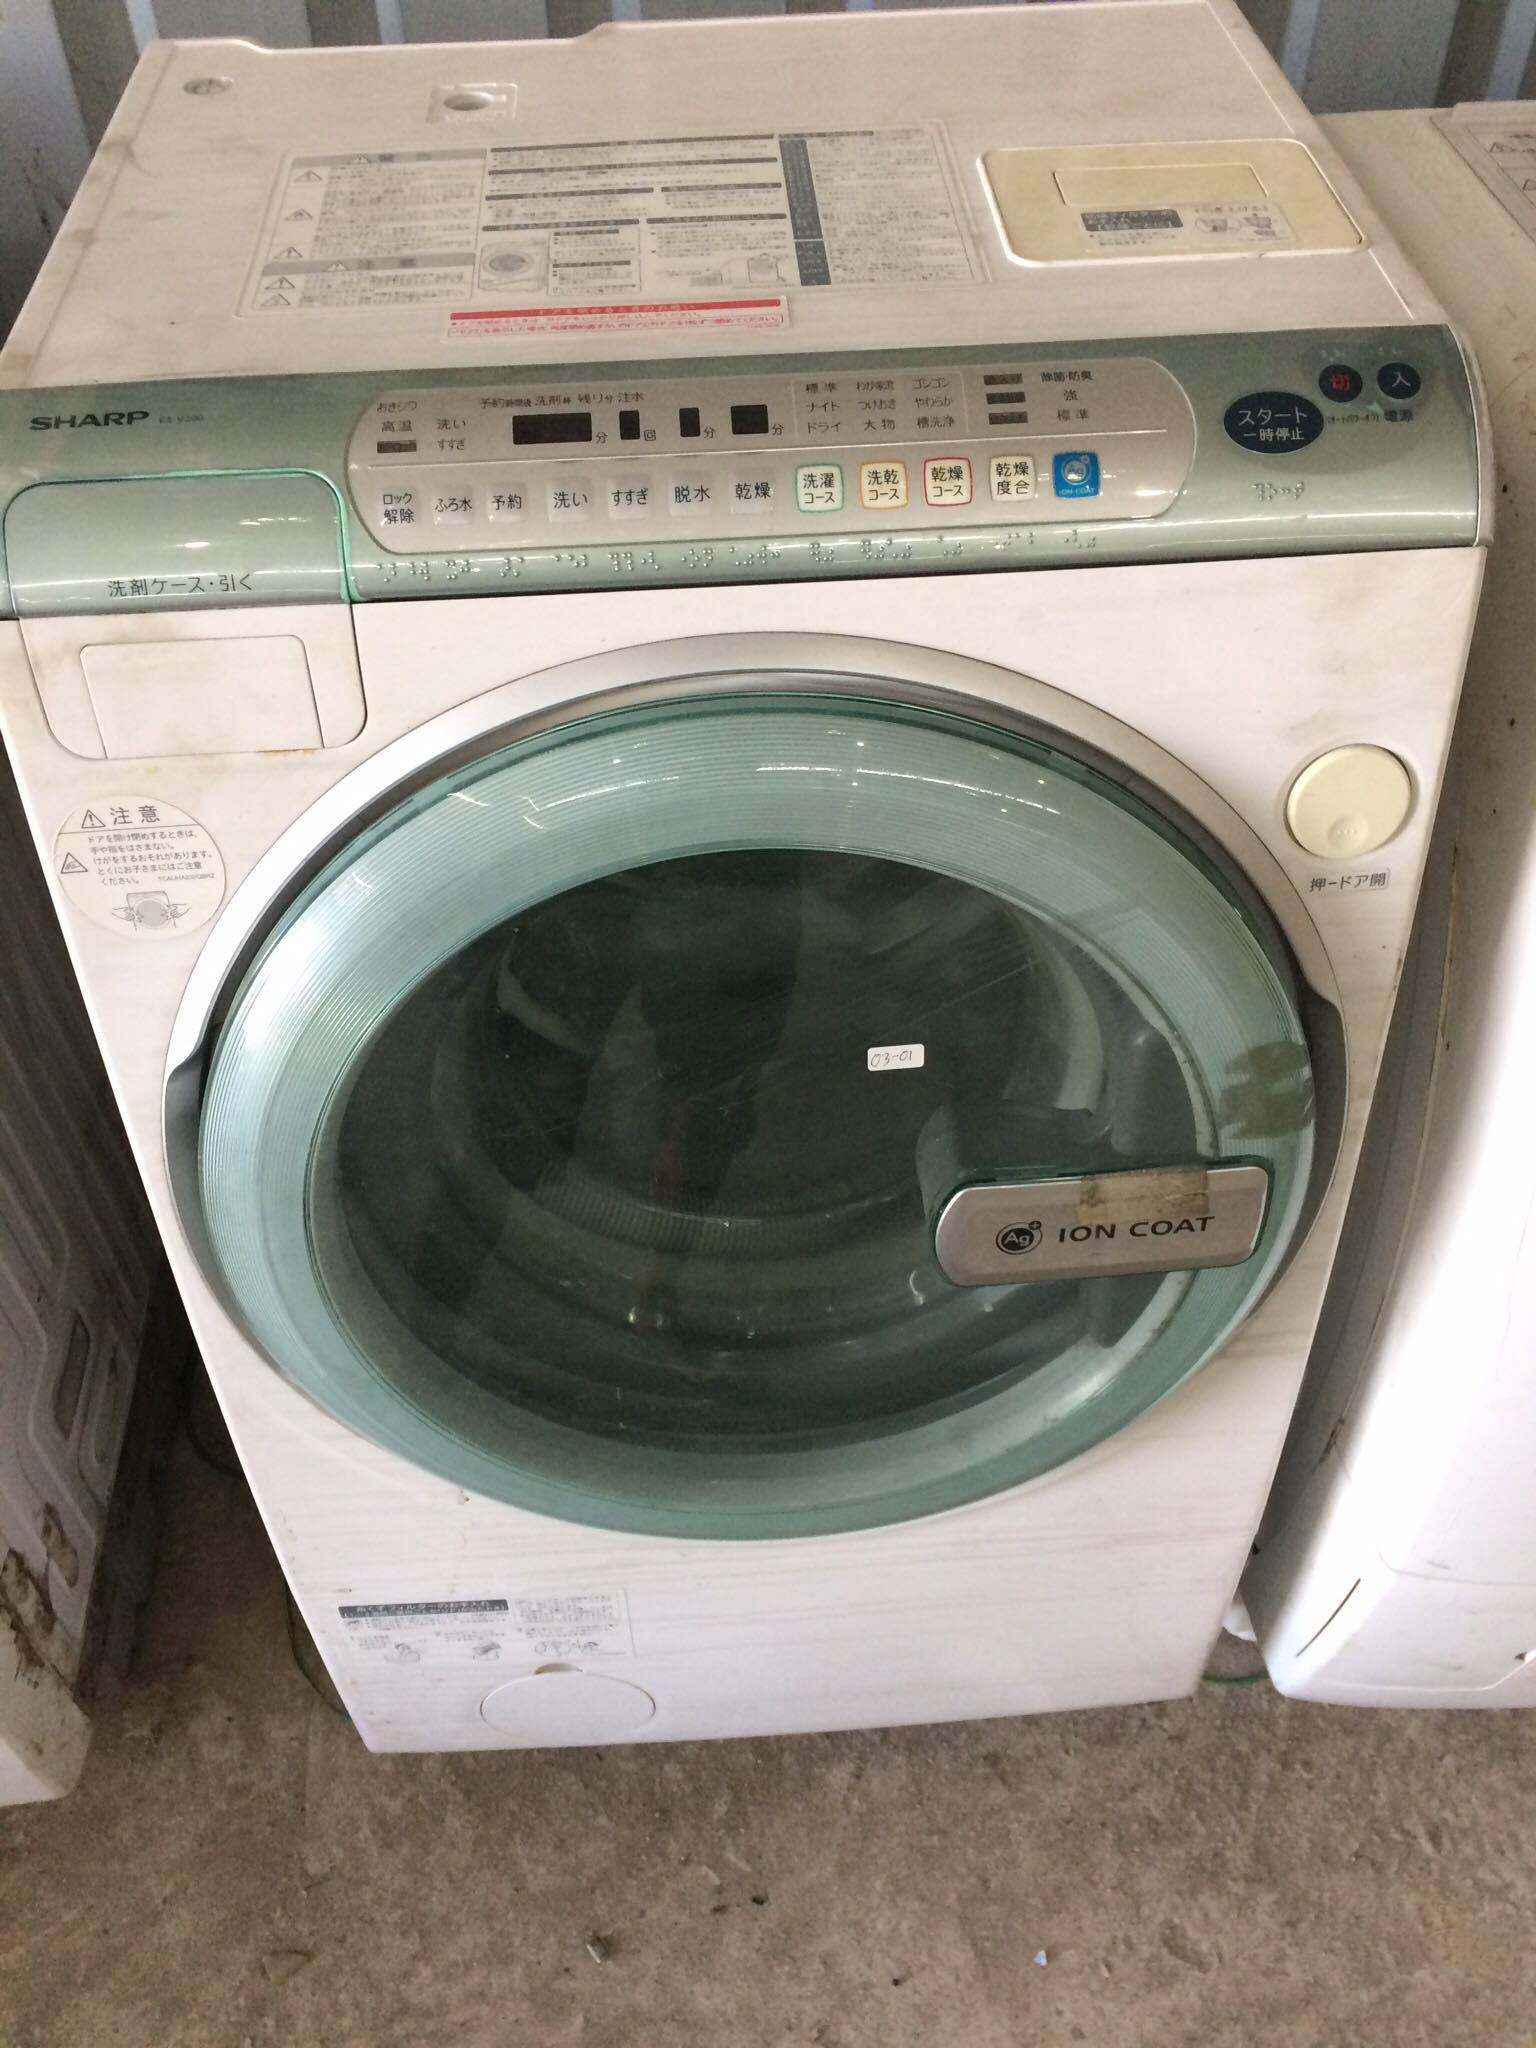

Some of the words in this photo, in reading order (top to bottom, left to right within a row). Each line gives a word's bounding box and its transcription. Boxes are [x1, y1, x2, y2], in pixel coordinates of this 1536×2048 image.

[1391, 371, 1412, 388] 入
[806, 401, 841, 413] ナイト
[1238, 405, 1308, 426] スタート
[29, 410, 150, 431] SHARP
[437, 418, 467, 430] 洗い
[807, 421, 841, 434] ドライ
[863, 419, 896, 432] 大物
[595, 431, 609, 444] 分
[643, 429, 657, 442] 回
[703, 426, 716, 439] 分
[771, 423, 785, 436] 分
[1243, 427, 1305, 443] 一時停止
[867, 469, 899, 486] 洗乾
[931, 465, 964, 482] 乾燥
[995, 461, 1029, 478] 乾燥
[803, 472, 835, 489] 洗濯
[996, 480, 1030, 496] 度合
[383, 492, 413, 505] ロック
[611, 487, 648, 506] すすぎ
[674, 484, 711, 504] 脱水
[735, 481, 772, 500] 乾燥
[804, 491, 836, 504] コース
[868, 488, 900, 501] コース
[933, 484, 964, 498] コース
[435, 497, 473, 513] ふろ水
[491, 494, 522, 511] 予約
[552, 491, 588, 509] 洗い
[384, 508, 415, 525] 解除
[107, 573, 253, 598] 洗剤ケース・引く
[109, 804, 161, 826] 注意
[870, 1050, 913, 1068] 03-01
[1058, 1223, 1117, 1243] ION
[1129, 1215, 1216, 1238] COAT
